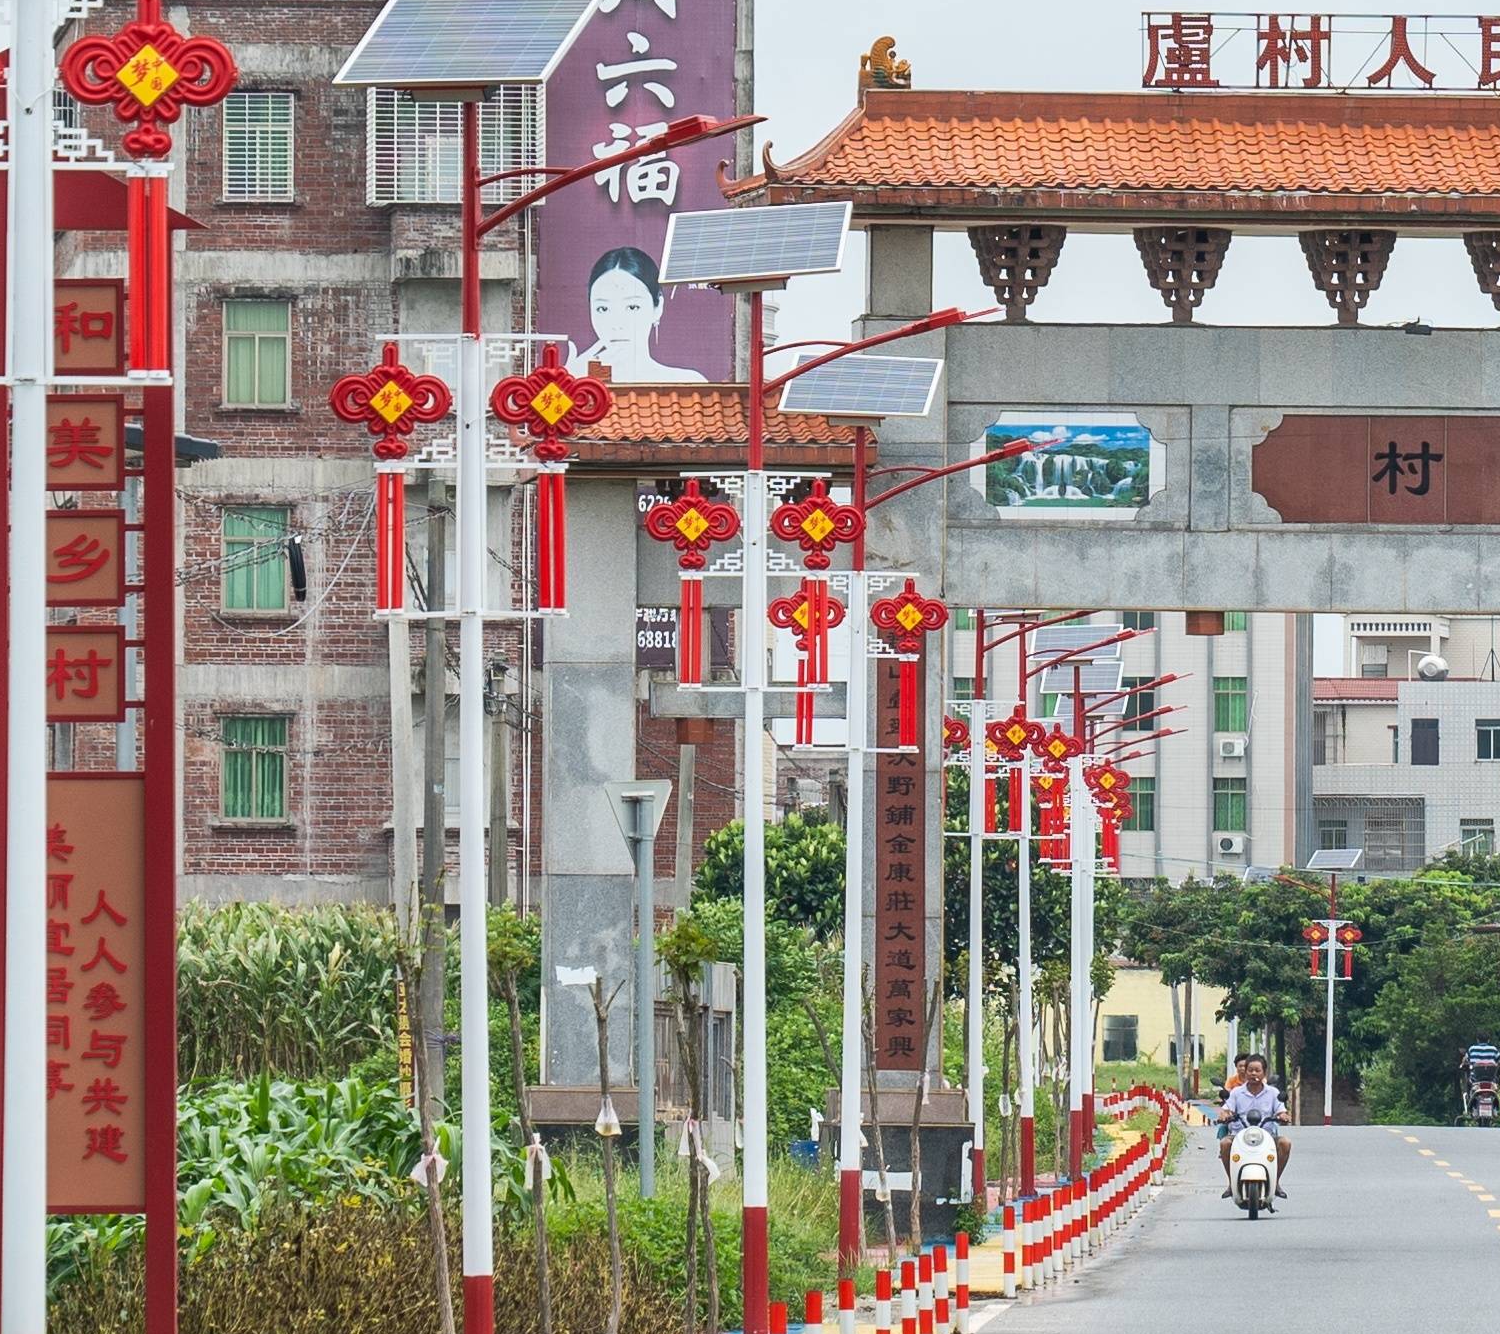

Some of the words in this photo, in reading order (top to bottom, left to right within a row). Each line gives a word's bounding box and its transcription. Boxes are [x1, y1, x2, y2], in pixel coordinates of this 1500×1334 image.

[81, 888, 128, 1163] 人人参与共建
